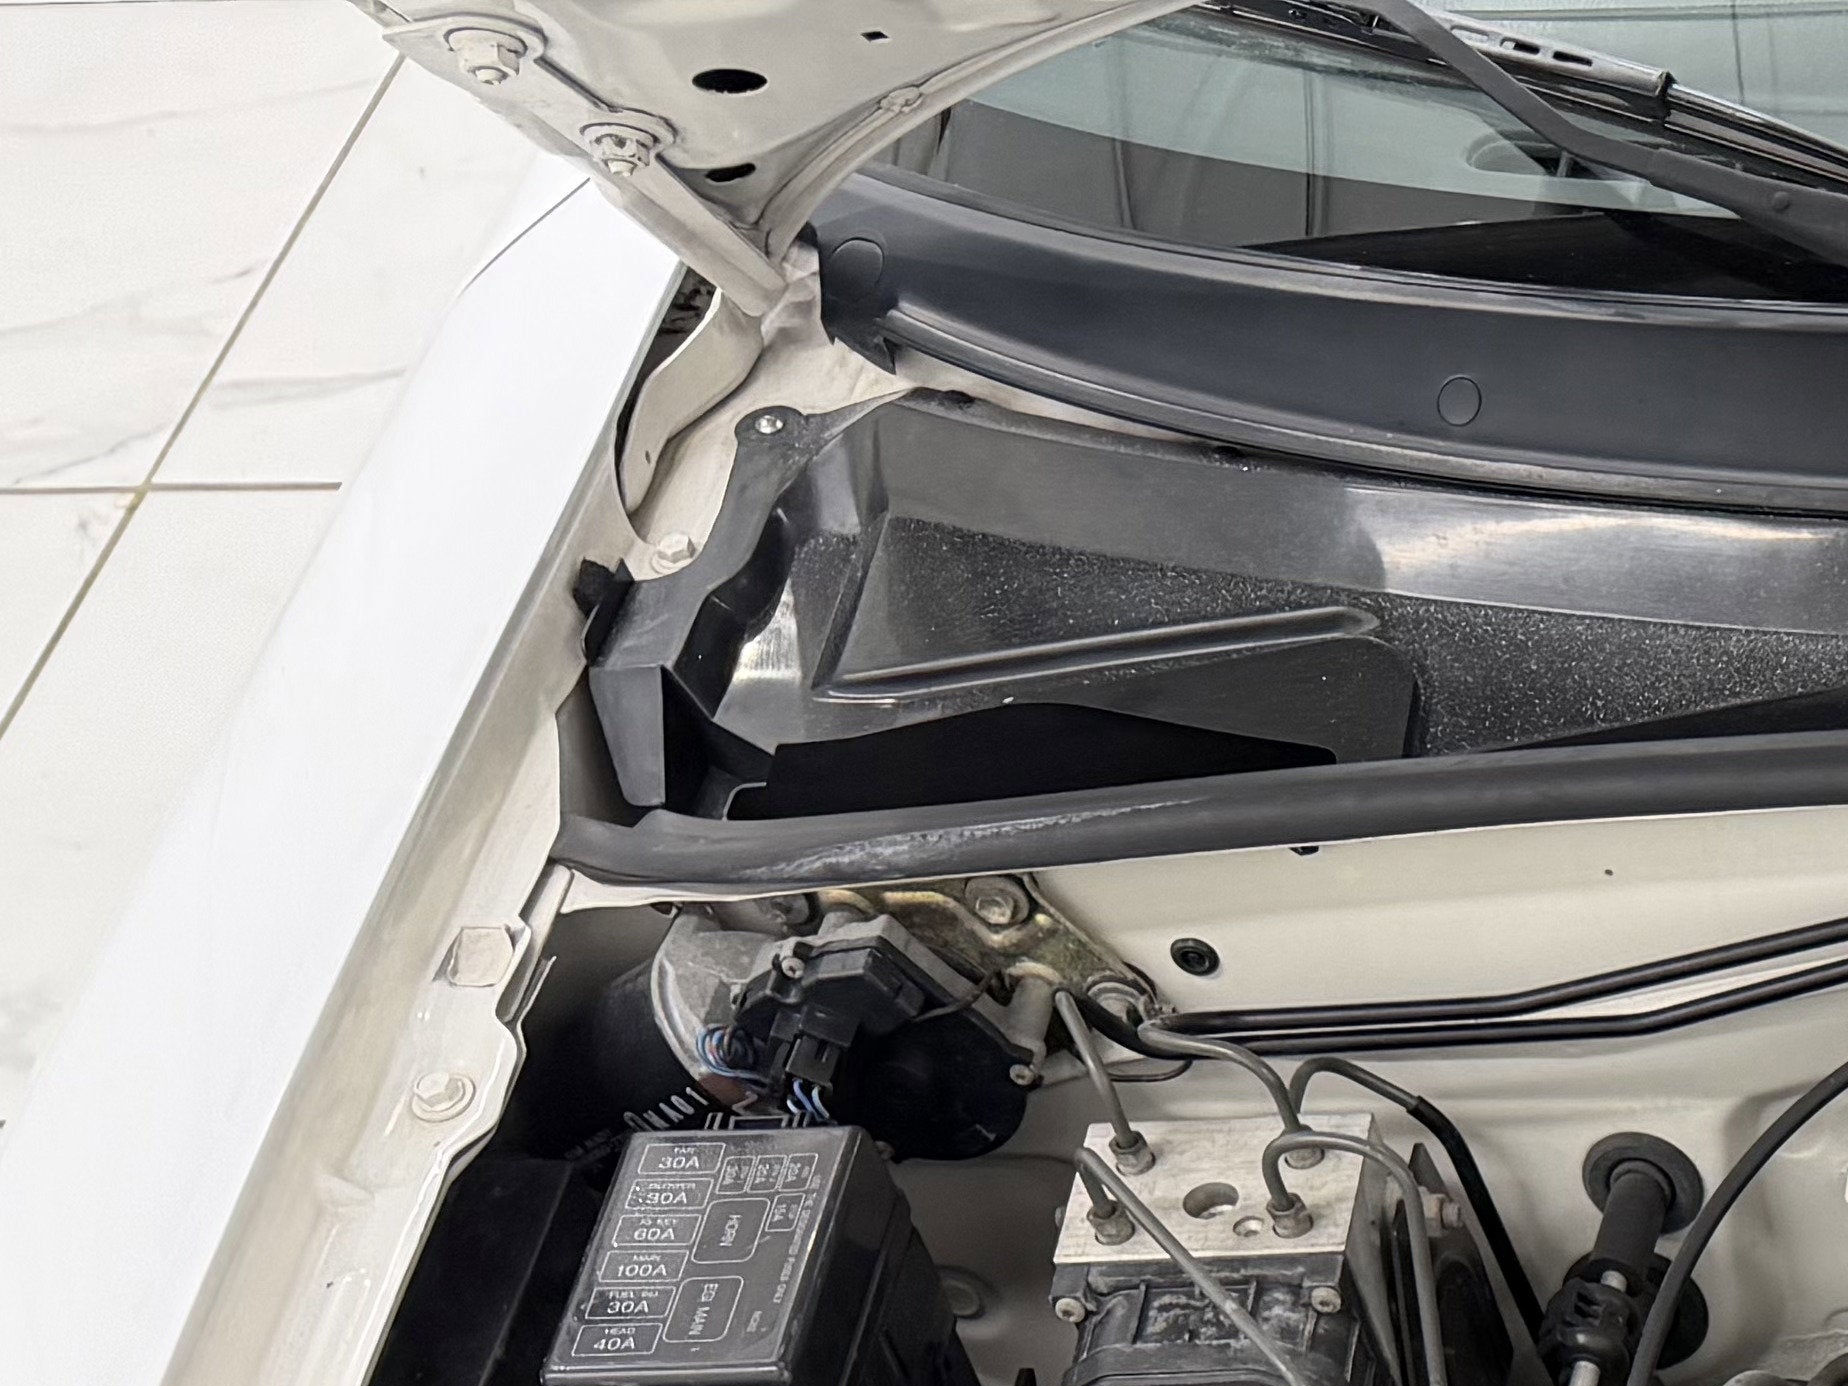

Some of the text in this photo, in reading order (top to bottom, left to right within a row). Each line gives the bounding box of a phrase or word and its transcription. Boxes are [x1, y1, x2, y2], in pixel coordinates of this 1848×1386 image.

[658, 1156, 699, 1169] 30A
[617, 1264, 667, 1277] 100A
[607, 1300, 649, 1314] 30A
[593, 1336, 635, 1350] 40A
